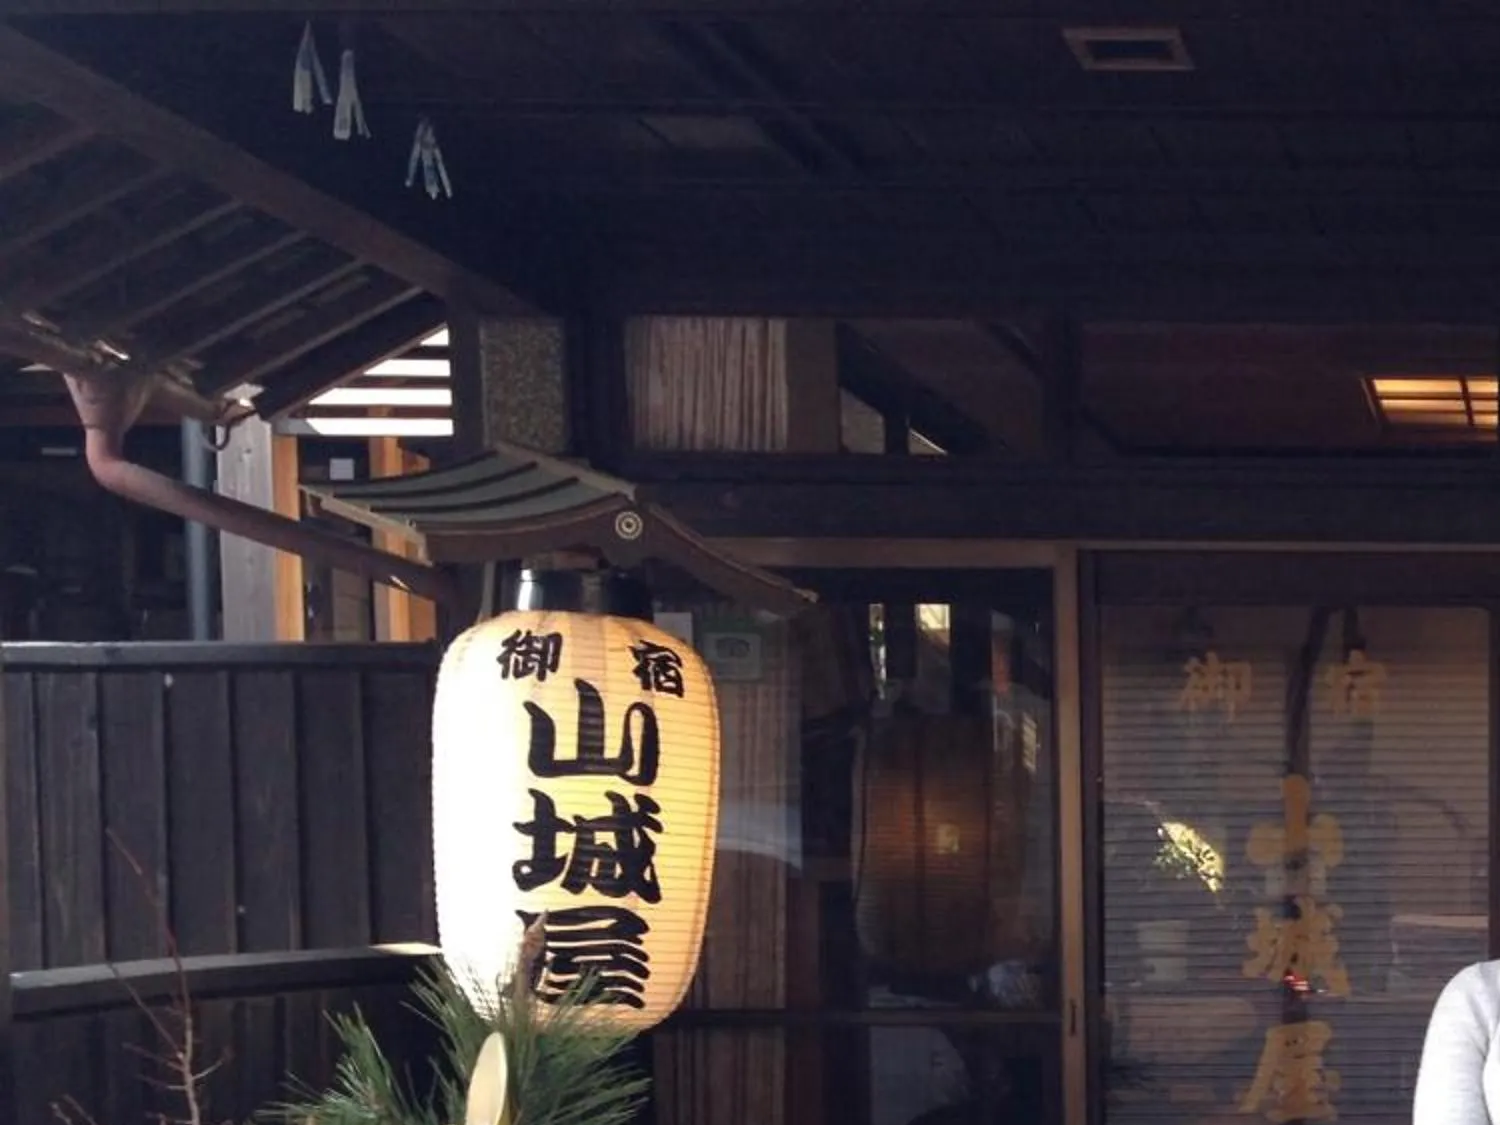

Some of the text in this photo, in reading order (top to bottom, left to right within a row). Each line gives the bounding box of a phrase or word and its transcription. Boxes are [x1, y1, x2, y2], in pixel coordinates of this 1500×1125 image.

[497, 629, 685, 699] 御 宿
[511, 677, 664, 1010] 山城屋
